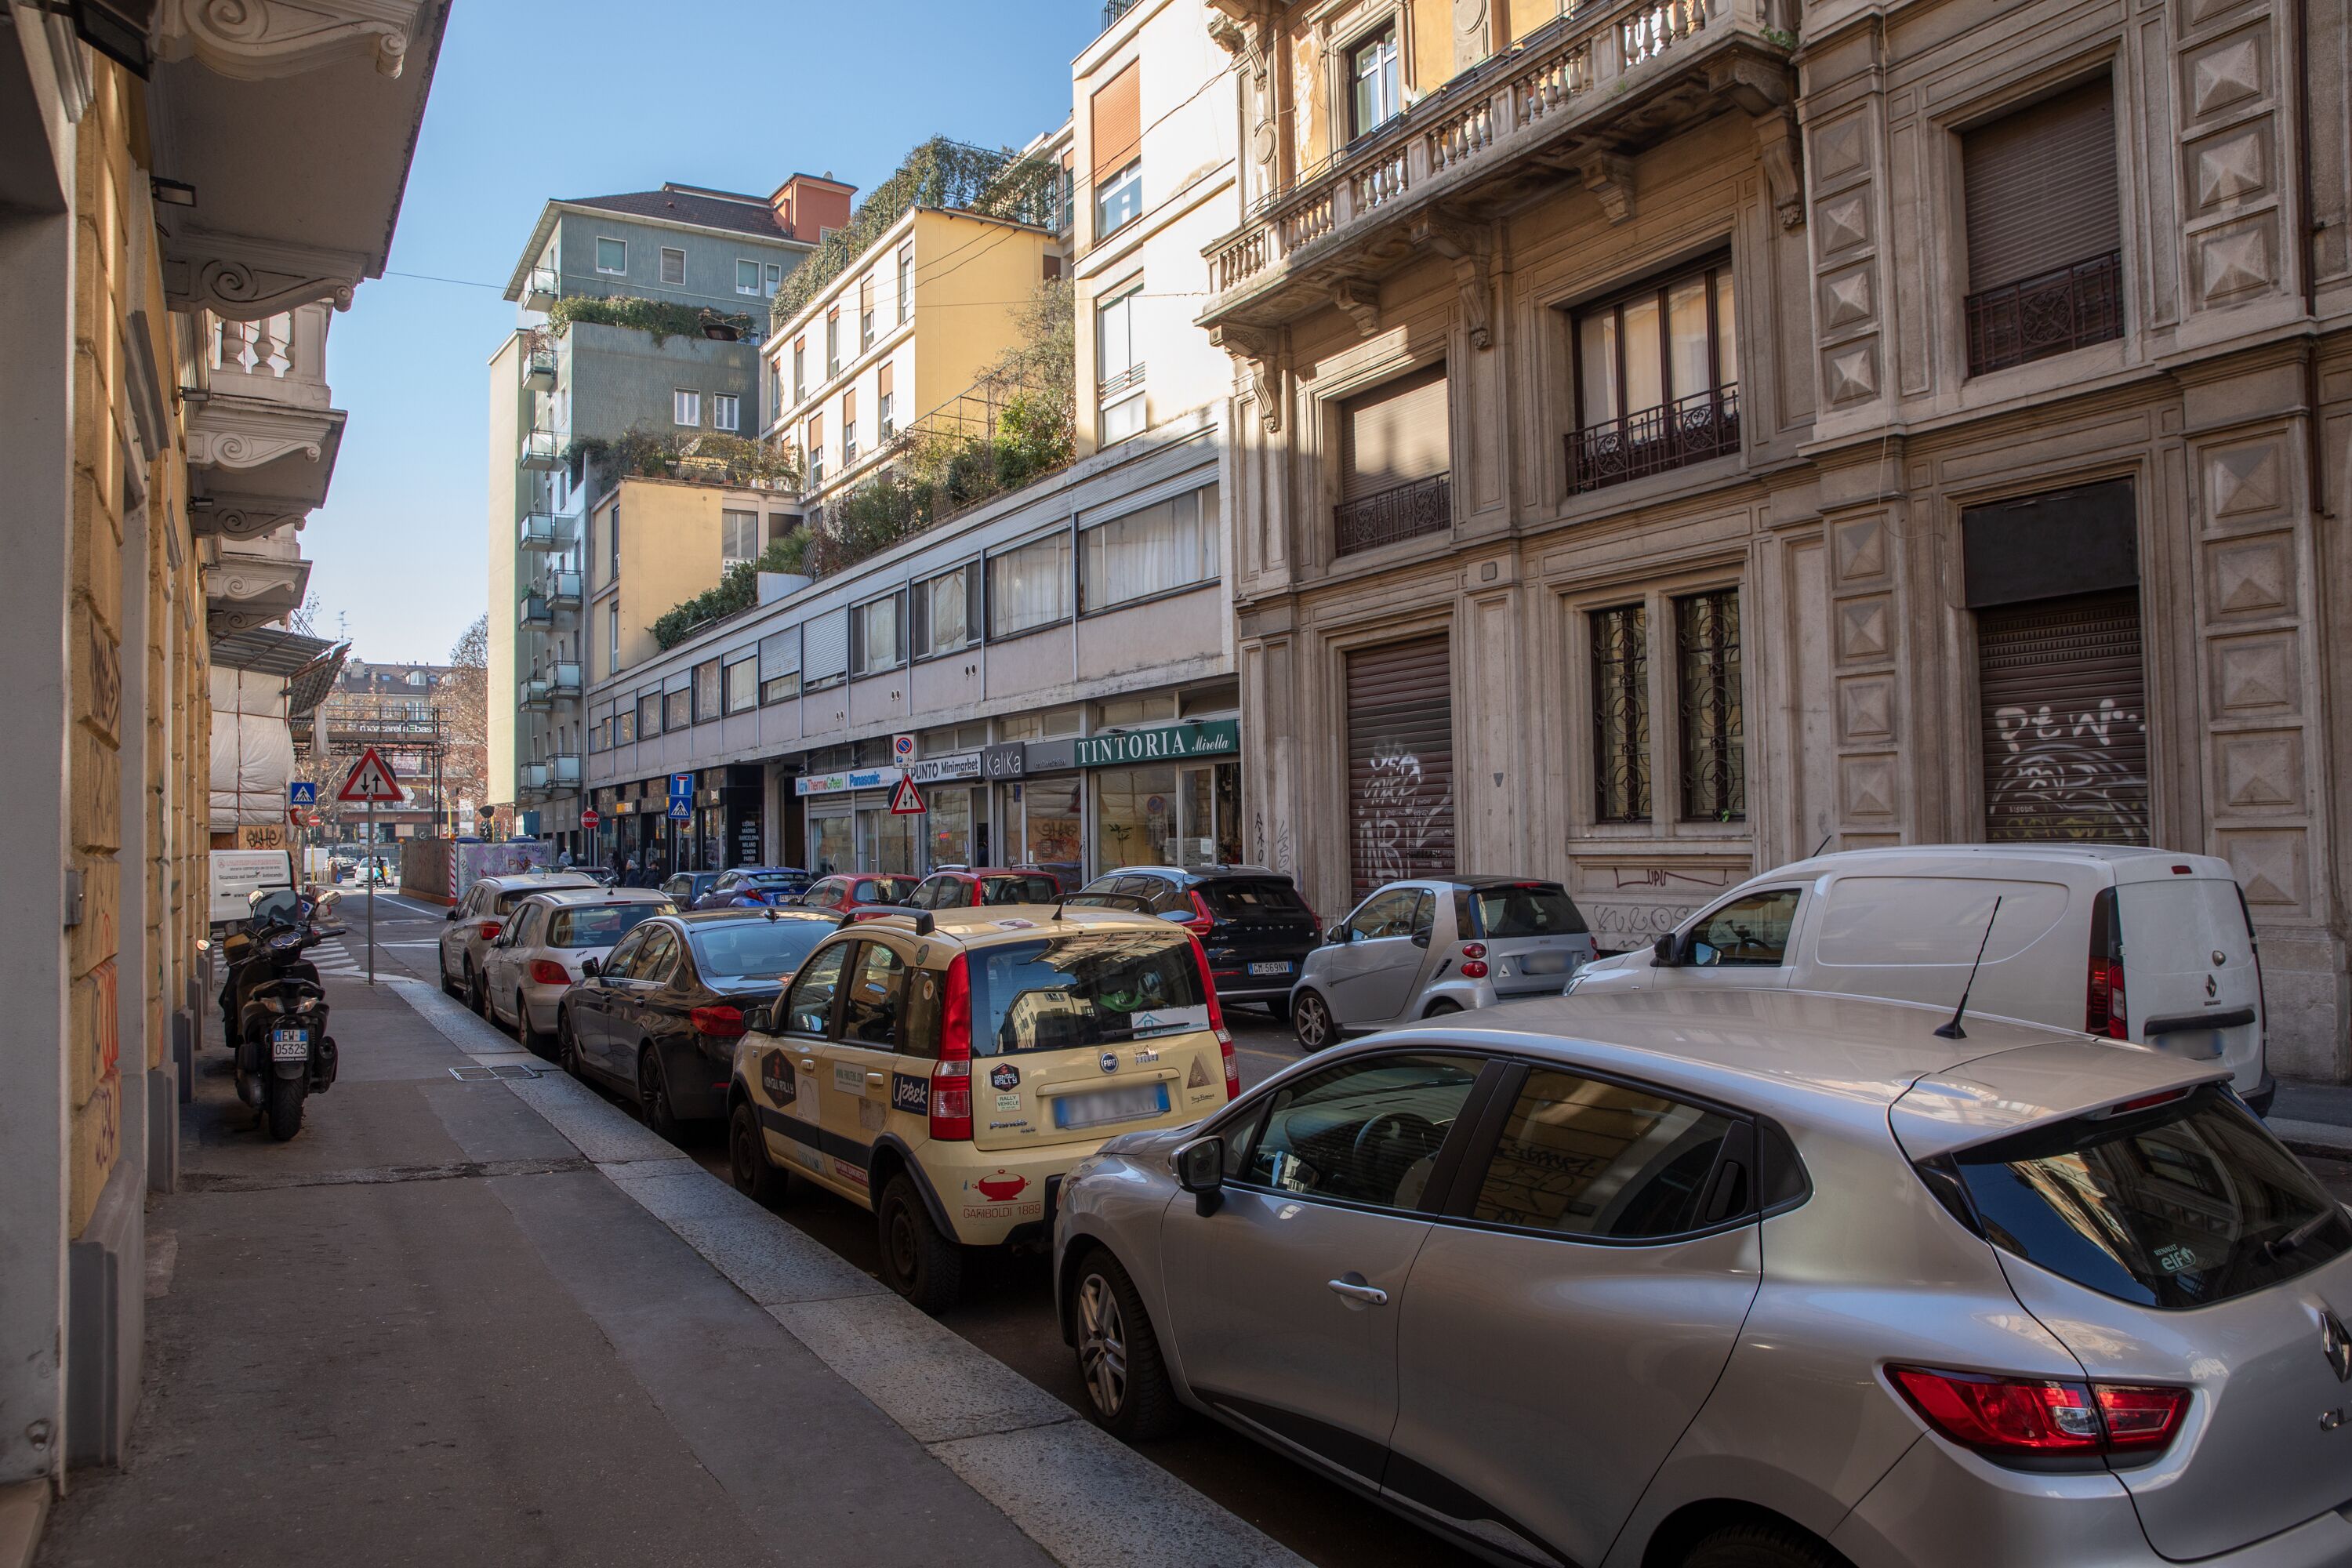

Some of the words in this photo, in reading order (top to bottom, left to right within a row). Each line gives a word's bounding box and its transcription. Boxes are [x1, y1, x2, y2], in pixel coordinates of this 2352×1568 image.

[1078, 730, 1186, 764] TINTORIA
[1192, 734, 1230, 753] Mirella
[911, 762, 938, 781] PUNTO
[941, 758, 978, 775] Minimarket
[987, 751, 1021, 776] KaliKa
[849, 771, 880, 787] Panasonic
[1254, 963, 1263, 973] GM
[1265, 961, 1287, 972] 569NV
[282, 1030, 295, 1041] EW
[275, 1044, 307, 1055] 05325
[1103, 1058, 1116, 1067] FIAT
[990, 1119, 1028, 1130] Panda
[964, 1207, 1012, 1218] GARIBOLDI
[1018, 1203, 1041, 1216] 1889
[2153, 1243, 2178, 1257] RENAULT
[2161, 1251, 2183, 1271] elf
